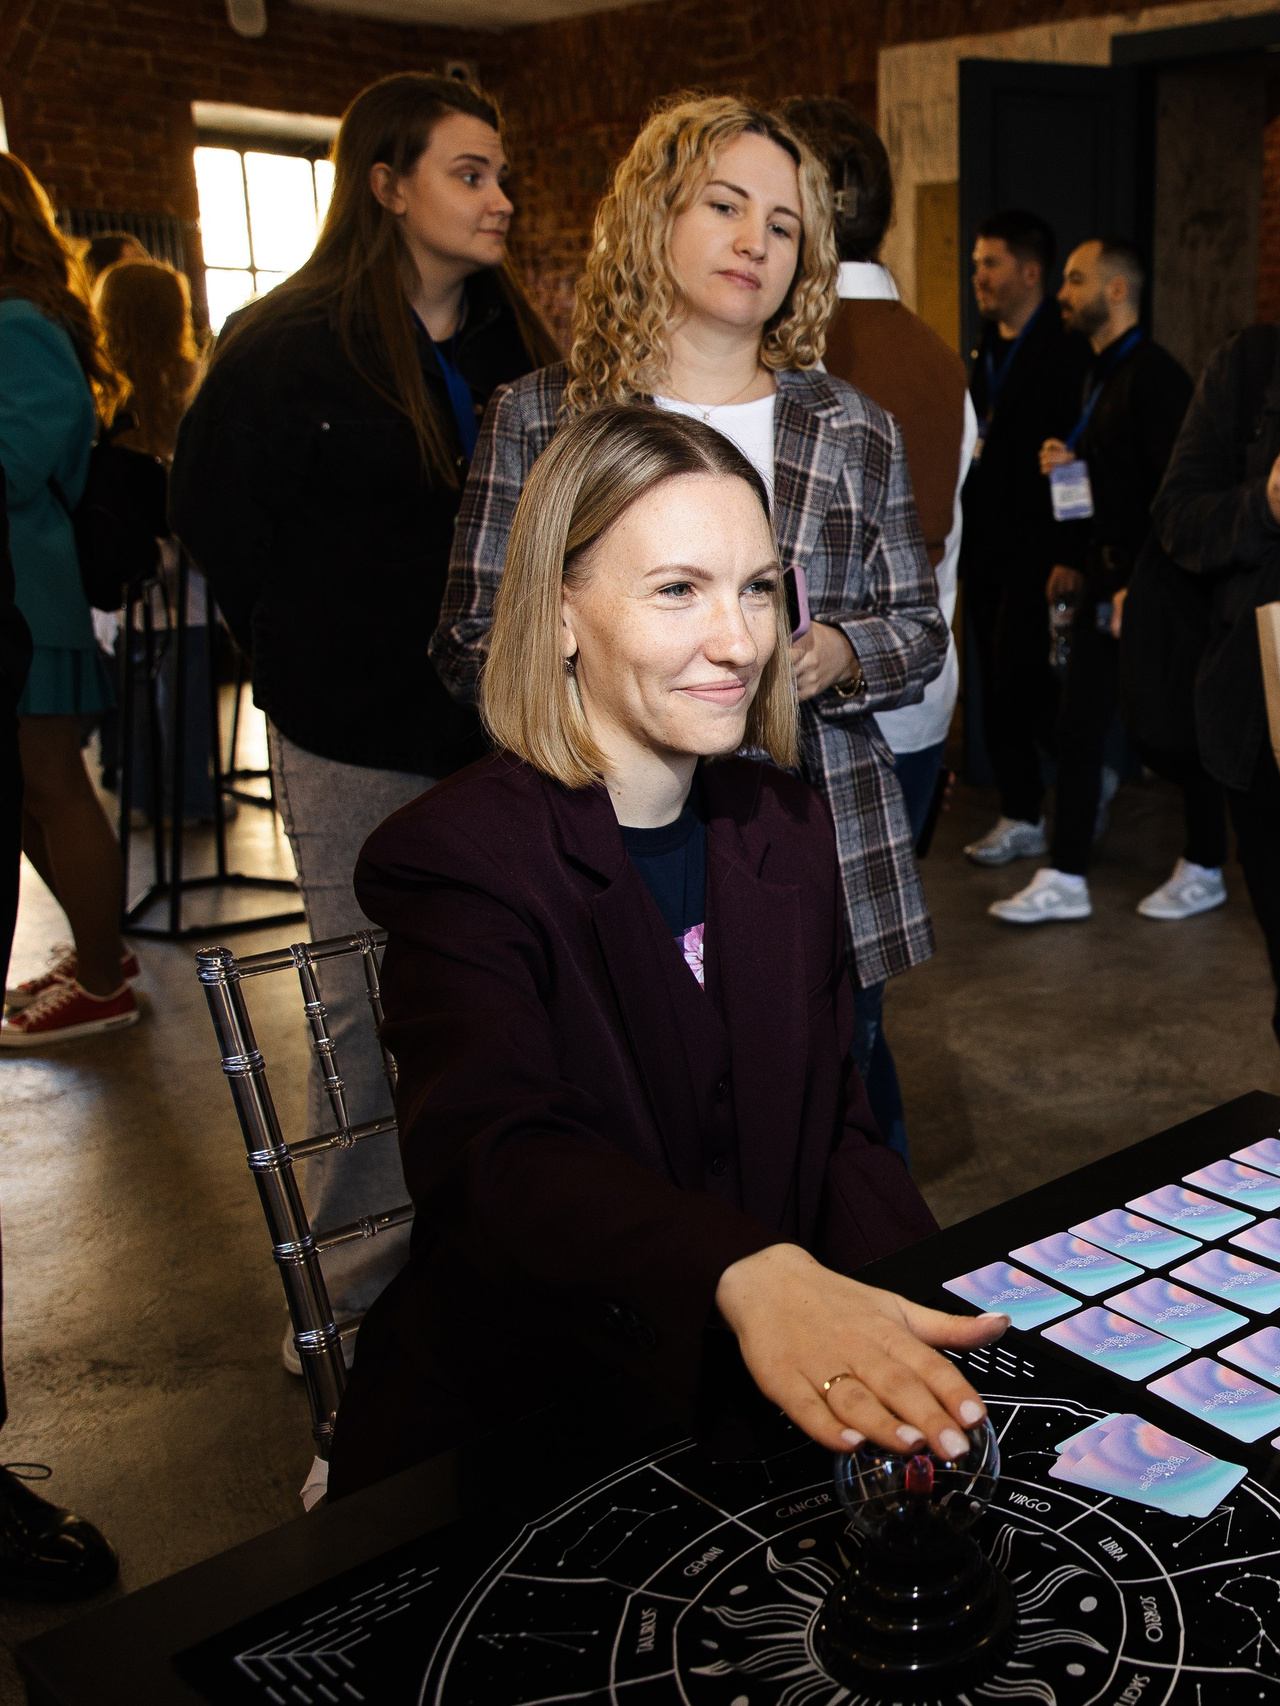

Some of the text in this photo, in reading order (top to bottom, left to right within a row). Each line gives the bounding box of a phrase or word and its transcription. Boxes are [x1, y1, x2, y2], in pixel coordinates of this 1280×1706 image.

[775, 1493, 832, 1519] CANCER
[1008, 1491, 1052, 1513] VIRGO
[683, 1546, 725, 1577] GEMINI
[1098, 1536, 1128, 1563] LIBRA
[635, 1607, 659, 1655] TAURUS
